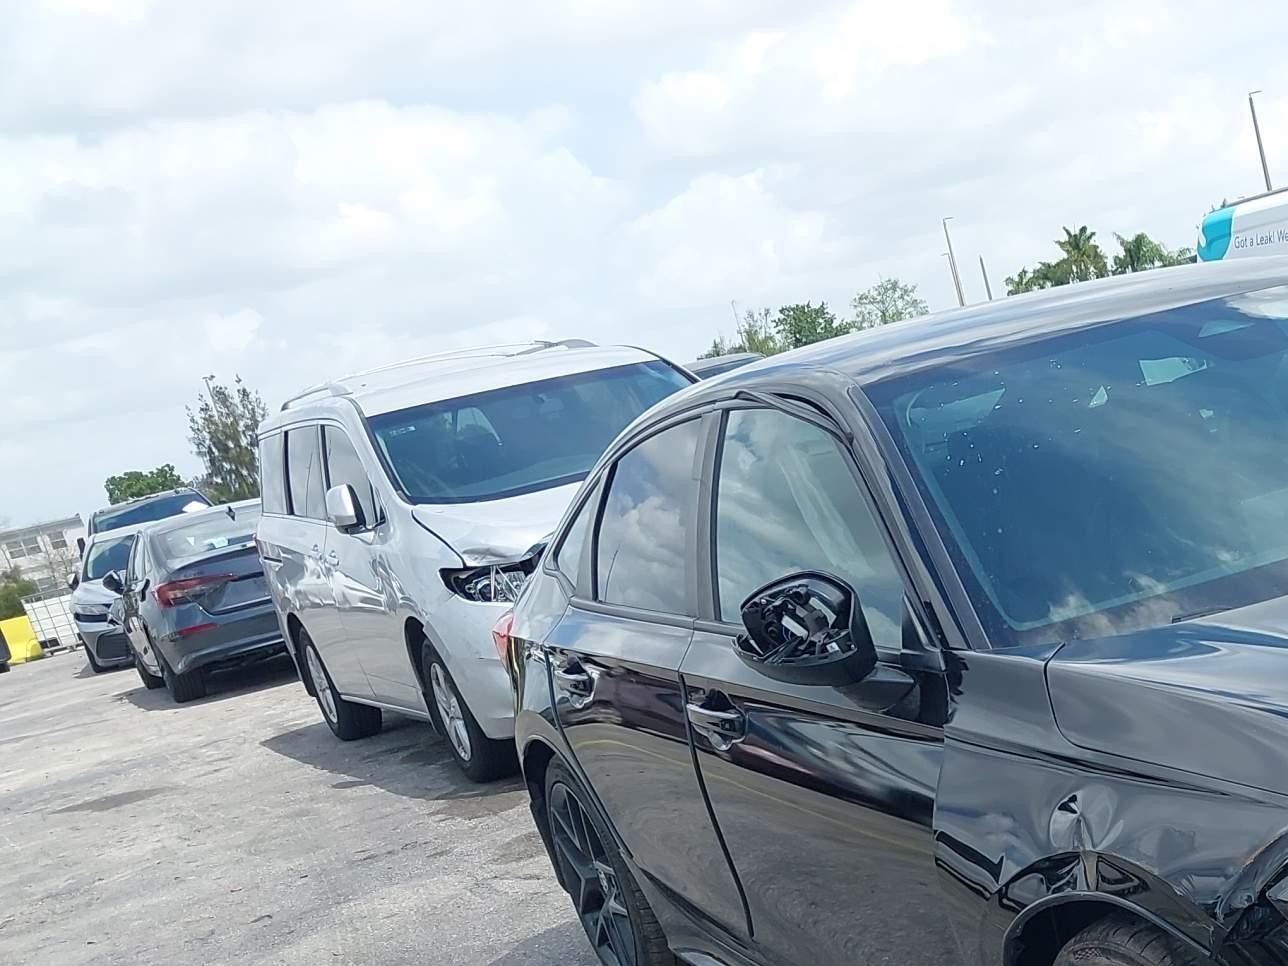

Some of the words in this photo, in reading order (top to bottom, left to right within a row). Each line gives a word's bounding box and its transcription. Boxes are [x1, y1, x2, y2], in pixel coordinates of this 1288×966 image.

[1234, 235, 1248, 249] Got
[1250, 238, 1254, 247] a
[1256, 232, 1275, 246] Leak!
